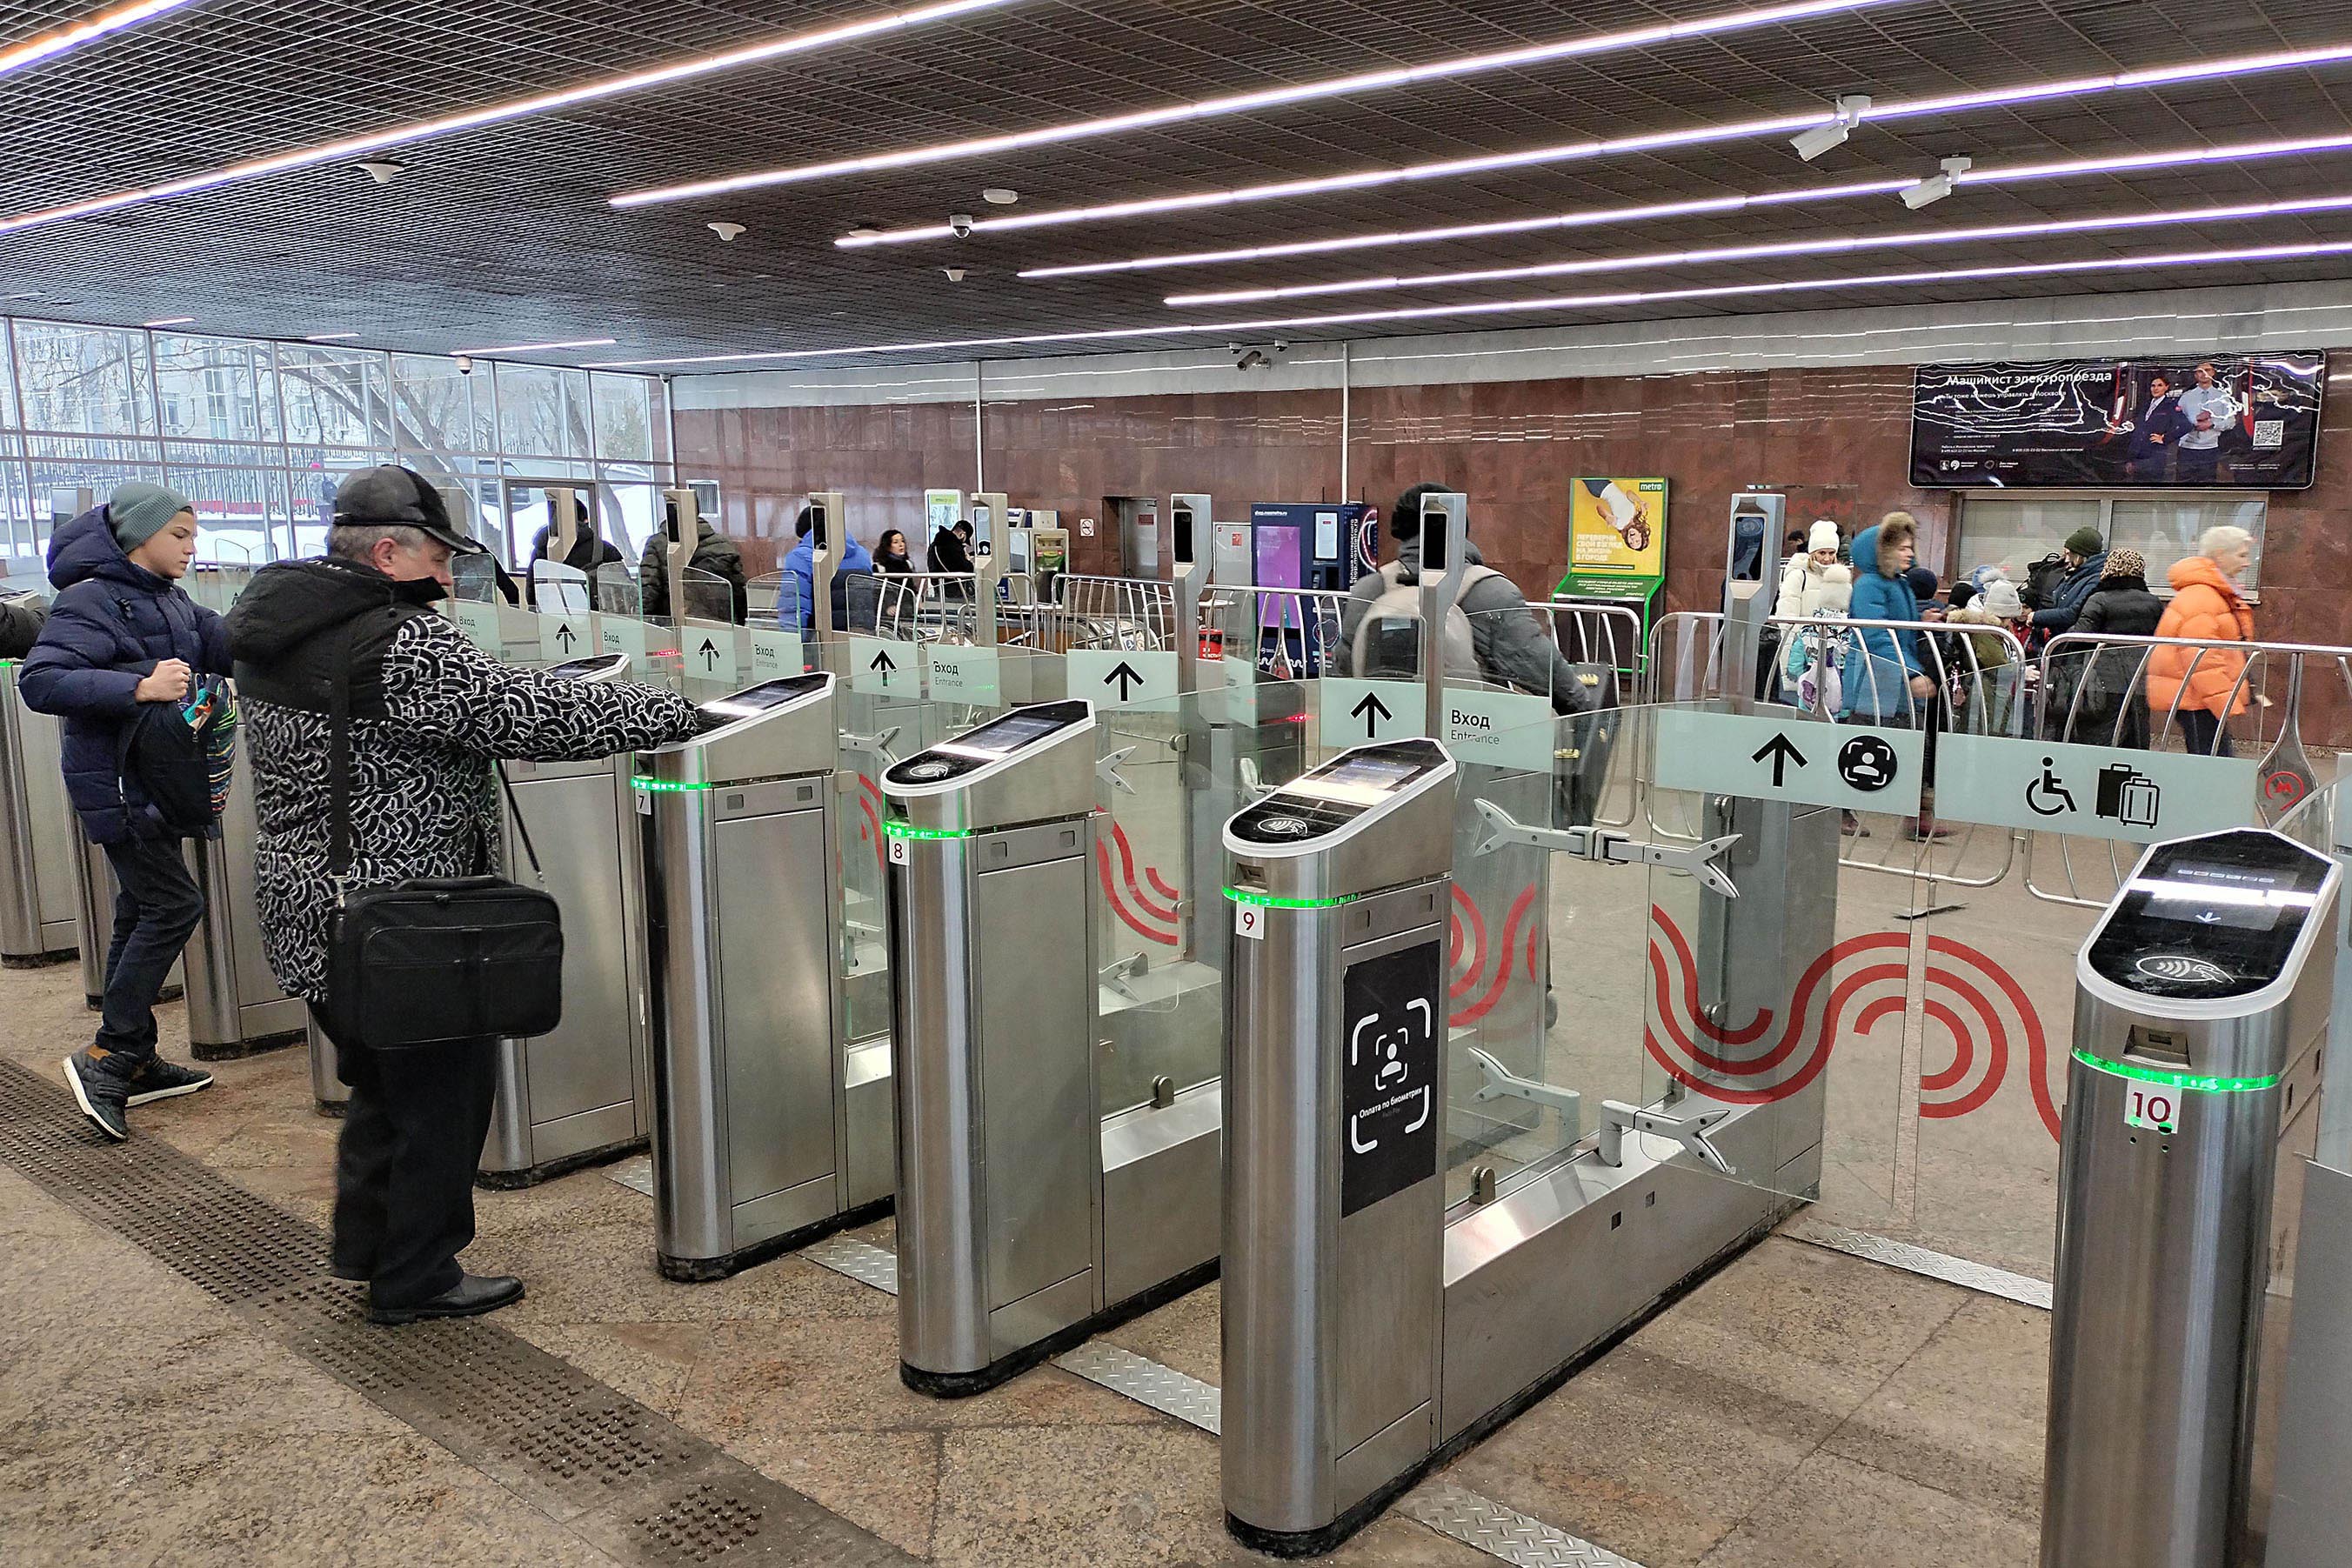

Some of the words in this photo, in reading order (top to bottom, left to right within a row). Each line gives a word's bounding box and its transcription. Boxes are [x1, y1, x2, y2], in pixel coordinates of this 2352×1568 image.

[1948, 375, 2012, 385] Машинист
[2015, 371, 2112, 384] электропоезда
[458, 616, 475, 628] Вход
[604, 631, 620, 644] Вход
[754, 644, 775, 659] Вход
[932, 660, 959, 677] Вход
[935, 677, 963, 688] Entrance
[1452, 709, 1490, 731] Вход
[1451, 730, 1500, 745] Entrance
[638, 795, 645, 810] 7
[893, 843, 903, 859] 8
[1243, 911, 1255, 931] 9
[1360, 1104, 1381, 1118] Оплата
[1381, 1100, 1390, 1110] по
[1390, 1087, 1422, 1105] биометрии
[2132, 1091, 2172, 1124] 10
